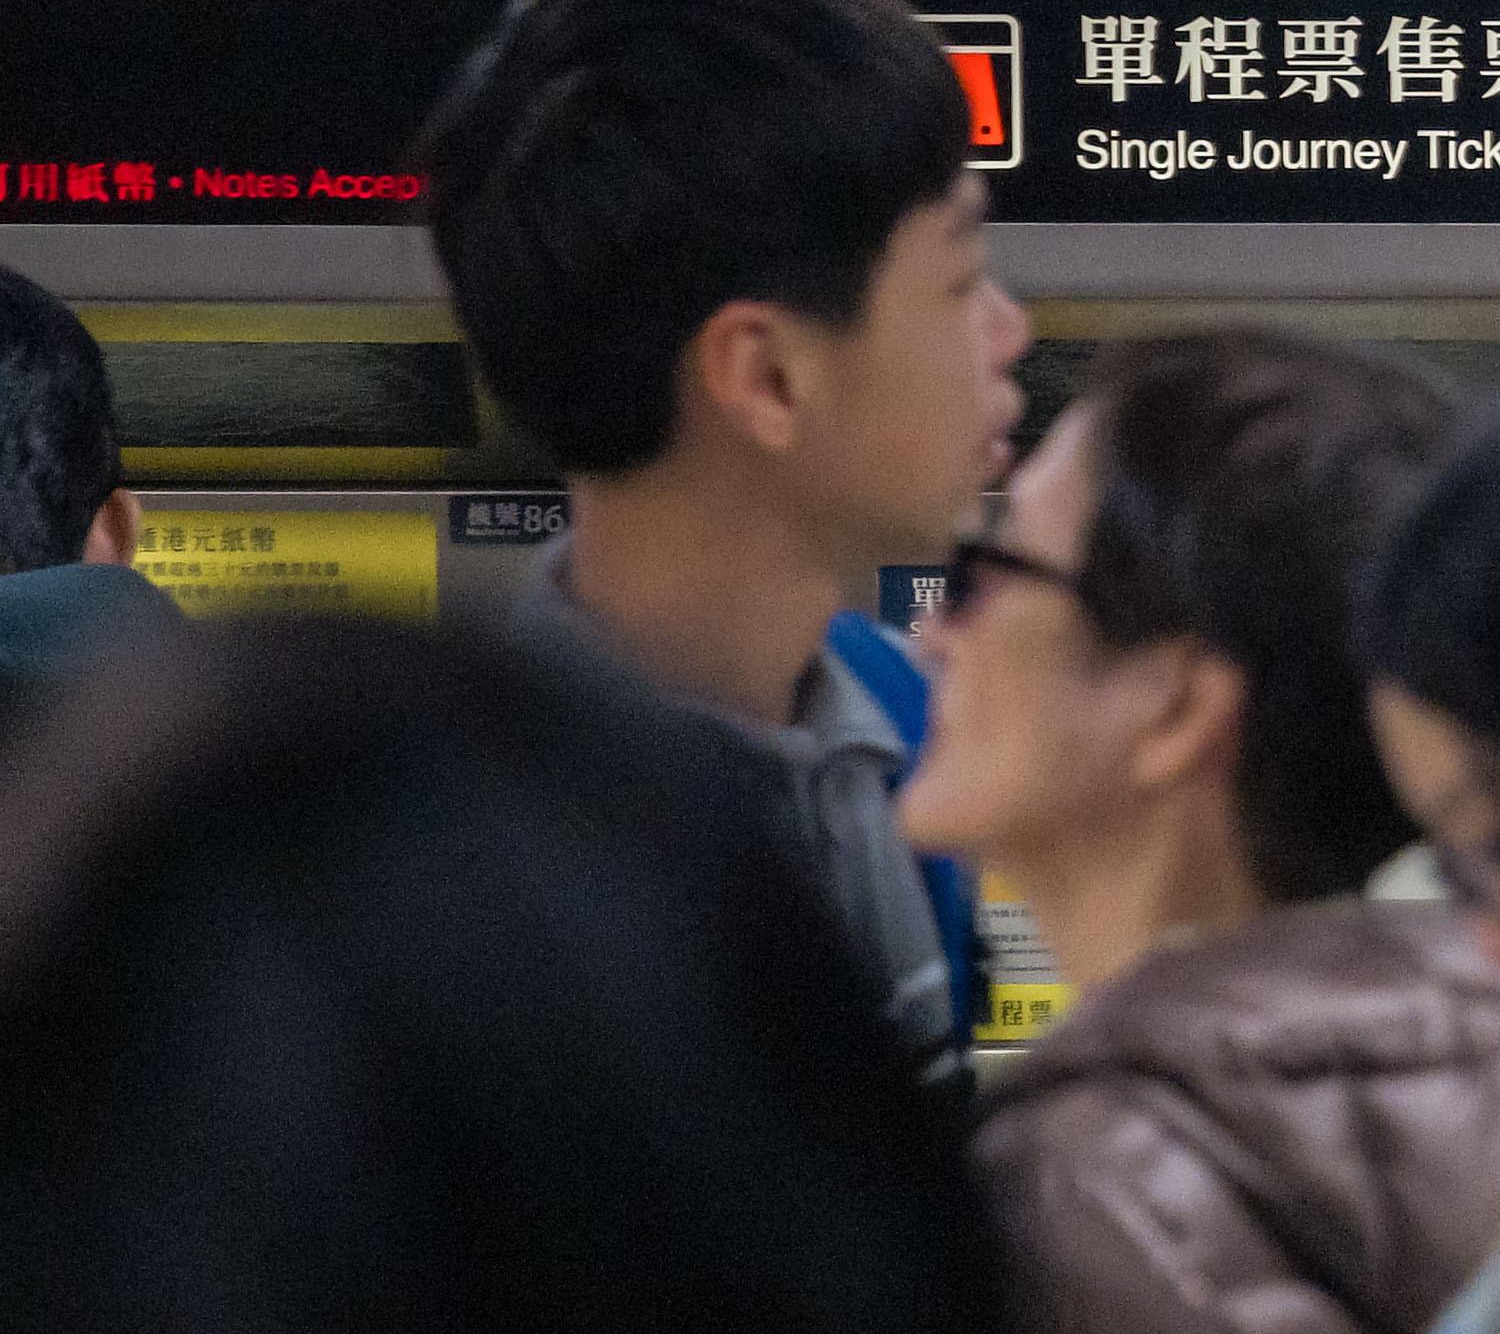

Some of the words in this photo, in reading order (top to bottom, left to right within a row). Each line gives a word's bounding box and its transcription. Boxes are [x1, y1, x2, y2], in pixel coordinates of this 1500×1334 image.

[1075, 129, 1215, 181] Single
[1227, 129, 1405, 181] Journey
[194, 168, 298, 199] Notes
[523, 504, 565, 534] 86
